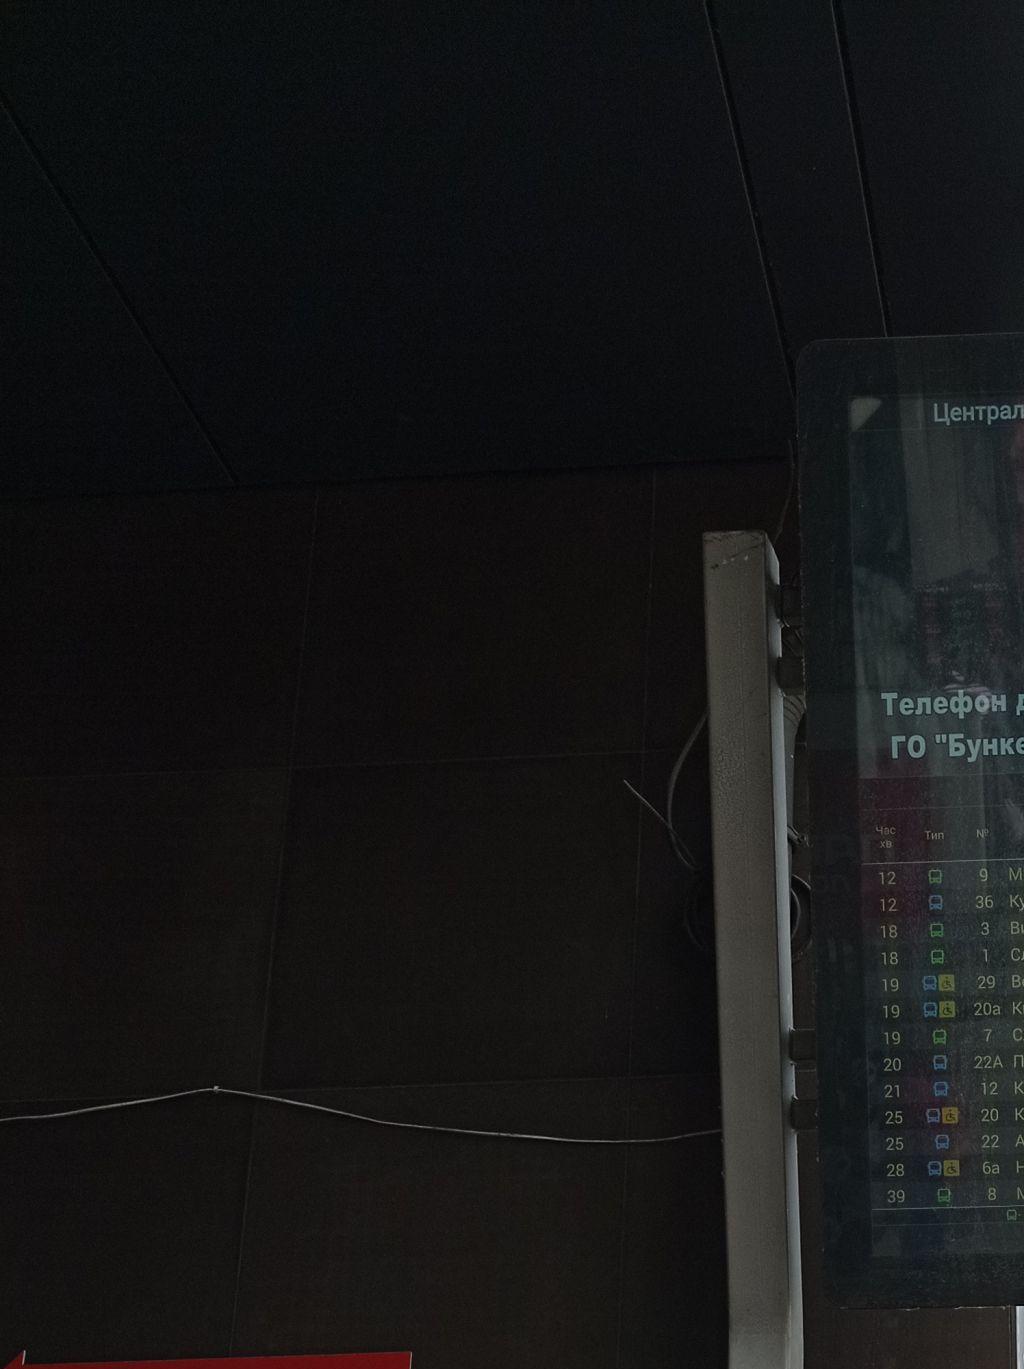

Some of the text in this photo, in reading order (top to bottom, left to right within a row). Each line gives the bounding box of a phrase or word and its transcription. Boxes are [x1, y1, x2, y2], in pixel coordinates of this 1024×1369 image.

[881, 689, 1007, 718] Телефон
[891, 735, 926, 759] ГО
[875, 826, 896, 836] Час
[924, 830, 945, 841] Тип
[879, 839, 893, 849] хв
[879, 871, 897, 885] 12
[979, 868, 989, 882] 9
[880, 898, 898, 912] 12
[975, 895, 994, 909] 36
[880, 925, 898, 939] 18
[980, 922, 990, 935] 3
[881, 951, 899, 966] 18
[982, 949, 989, 962] 1
[882, 978, 899, 992] 19
[977, 975, 996, 989] 29
[883, 1005, 900, 1018] 19
[884, 1031, 901, 1045] 19
[983, 1029, 993, 1042] 7
[883, 1058, 902, 1072] 20
[974, 1055, 1003, 1069] 22А
[884, 1084, 901, 1098] 21
[982, 1081, 998, 1095] 12
[885, 1110, 903, 1124] 25
[980, 1108, 999, 1122] 20
[885, 1137, 904, 1151] 25
[981, 1134, 999, 1149] 22
[886, 1163, 905, 1177] 28
[887, 1190, 906, 1204] 39
[987, 1187, 997, 1201] 8
